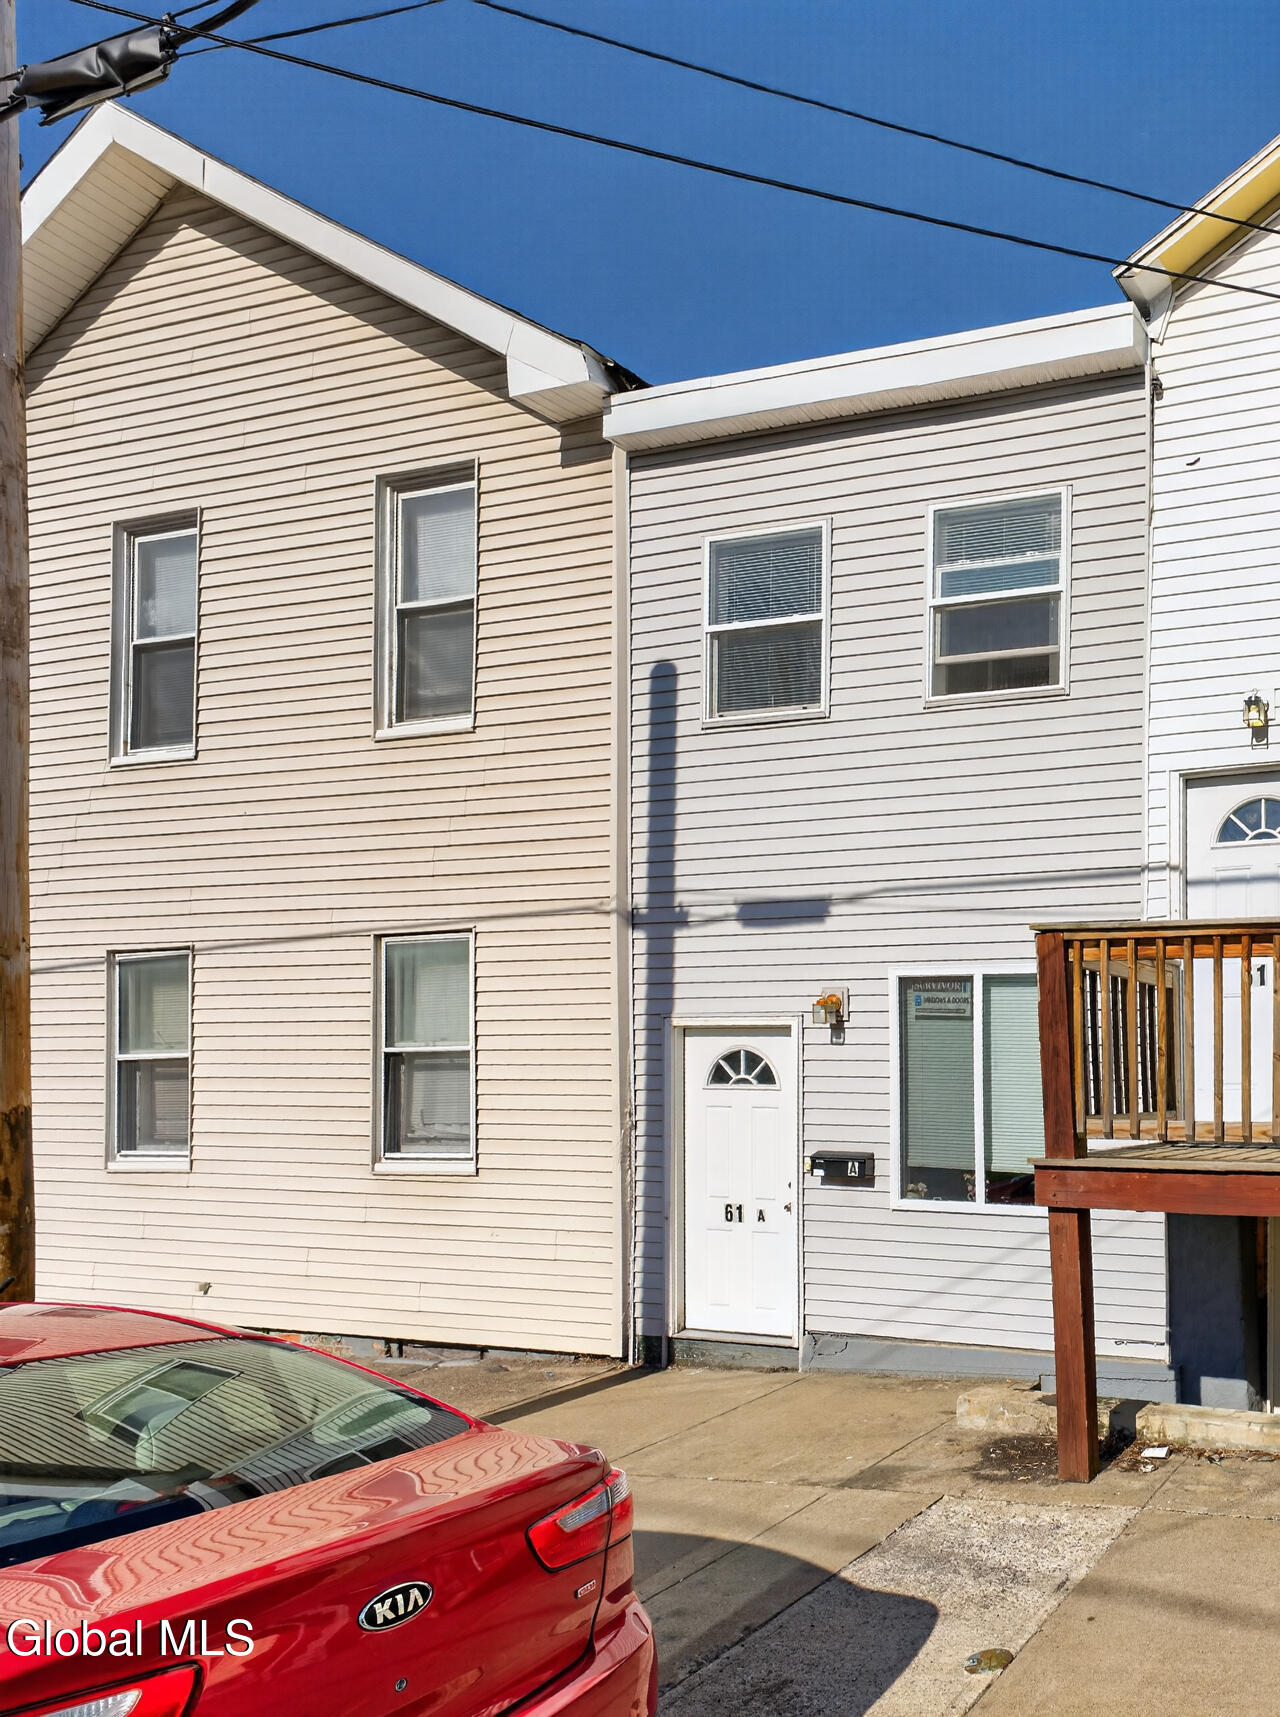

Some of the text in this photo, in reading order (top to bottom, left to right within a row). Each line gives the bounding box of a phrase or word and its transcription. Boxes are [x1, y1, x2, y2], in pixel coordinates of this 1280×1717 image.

[848, 1161, 858, 1175] A
[724, 1203, 766, 1223] 61 A
[373, 1587, 424, 1625] KIA
